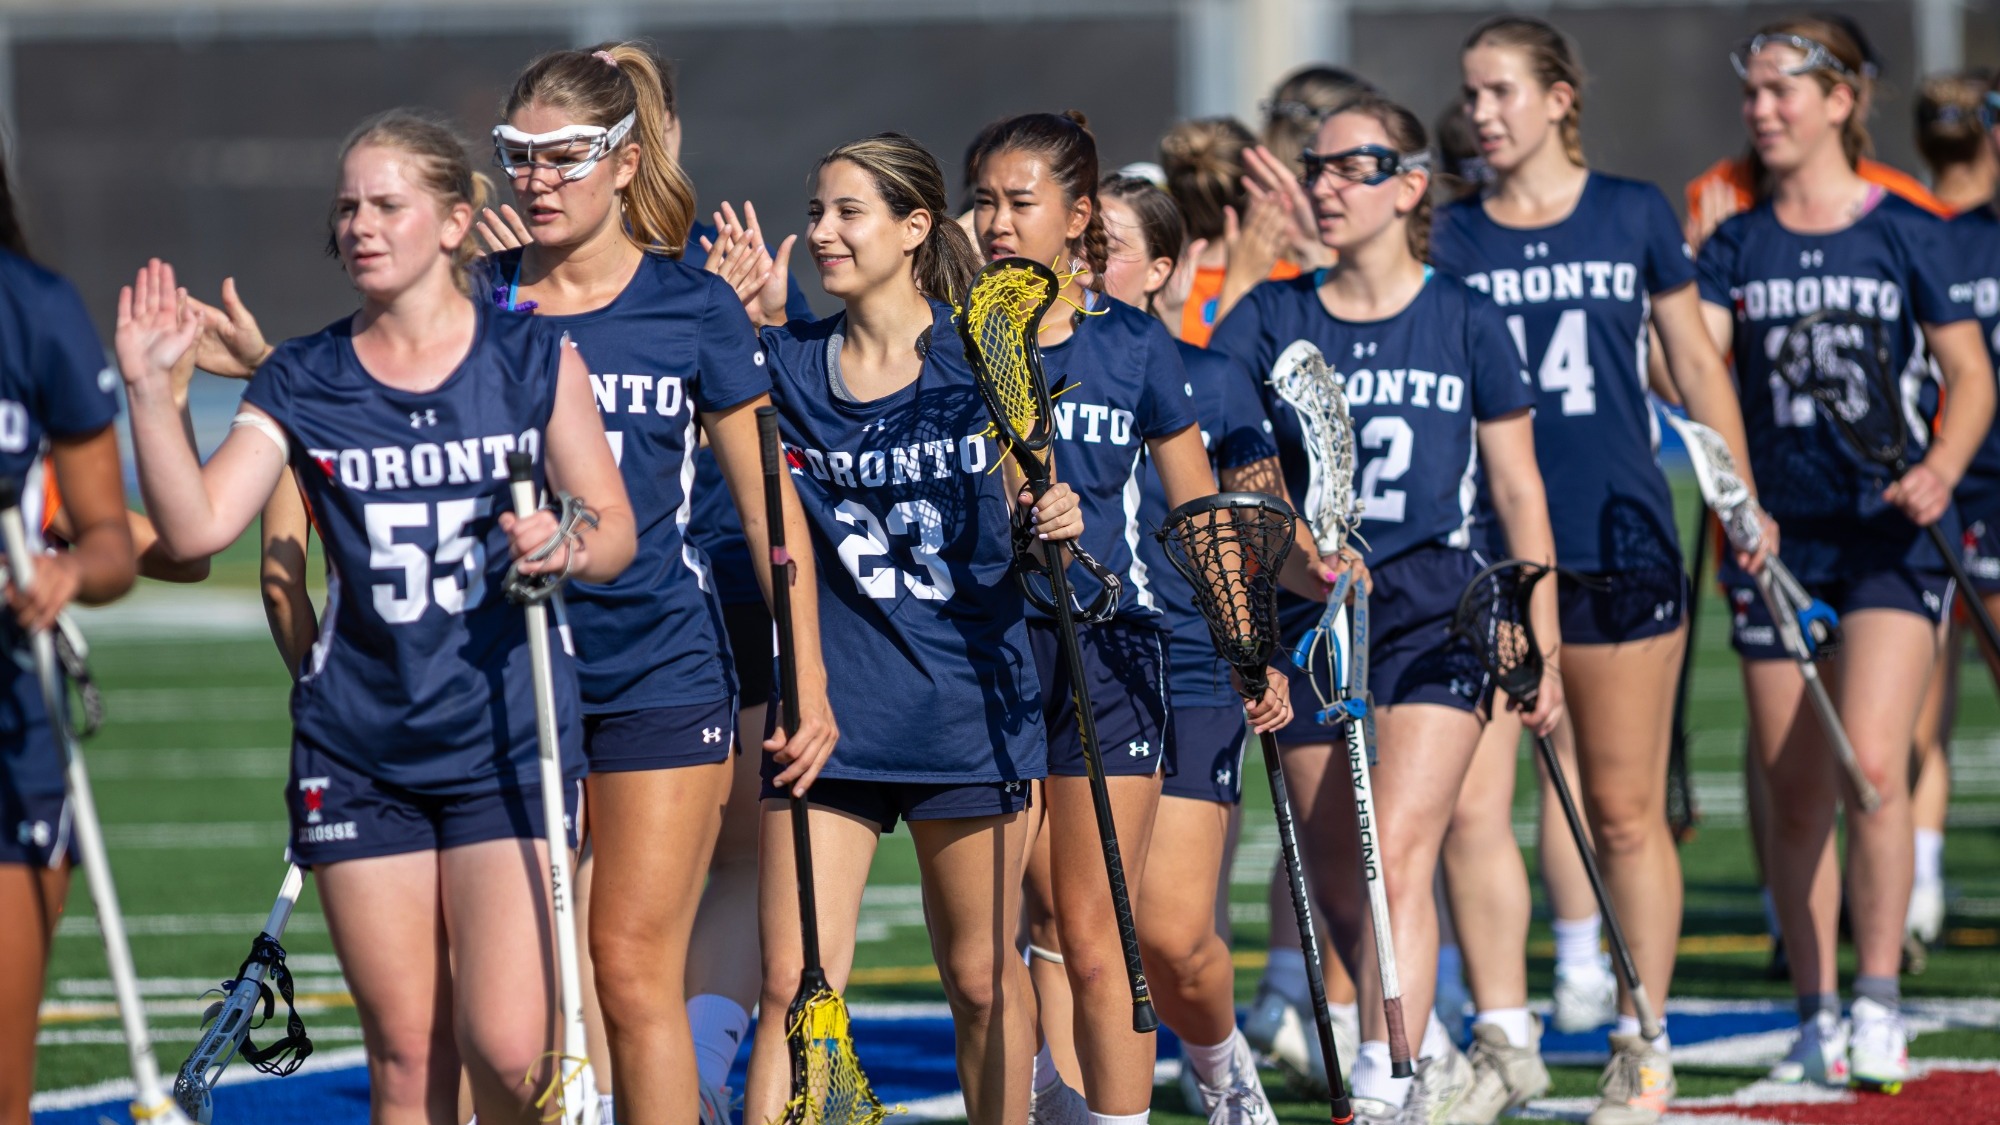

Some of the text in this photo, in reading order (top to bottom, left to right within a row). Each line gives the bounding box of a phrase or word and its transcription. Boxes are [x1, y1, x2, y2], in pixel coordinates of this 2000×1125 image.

[1350, 416, 1414, 523] 2
[364, 495, 494, 624] 55
[834, 499, 956, 601] 23
[1356, 799, 1378, 882] UNDER
